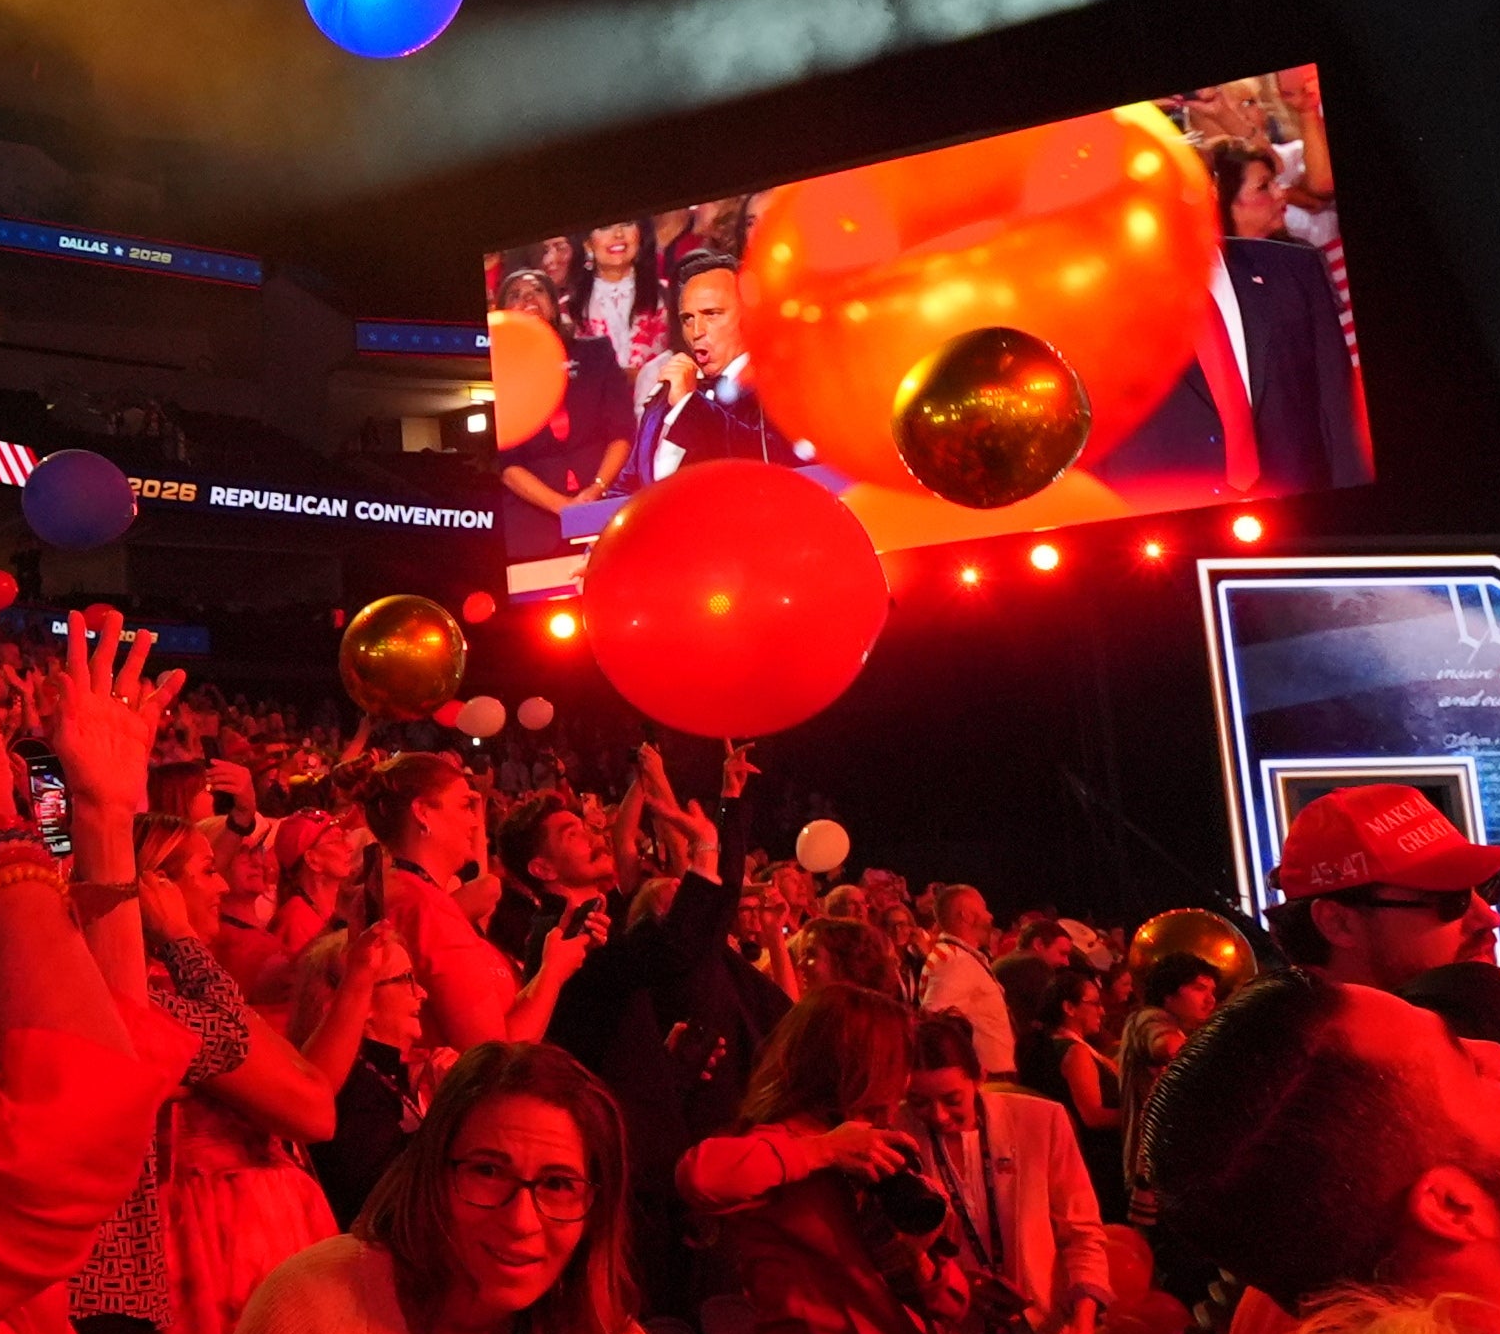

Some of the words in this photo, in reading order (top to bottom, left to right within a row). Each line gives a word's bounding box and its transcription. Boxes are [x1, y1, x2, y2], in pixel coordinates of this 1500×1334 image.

[59, 236, 110, 255] DALLAS
[128, 247, 173, 264] 2026
[128, 477, 198, 502] 2026
[210, 485, 348, 518] REPUBLICAN
[354, 500, 495, 530] CONVENTION
[1366, 799, 1420, 837] MAKE
